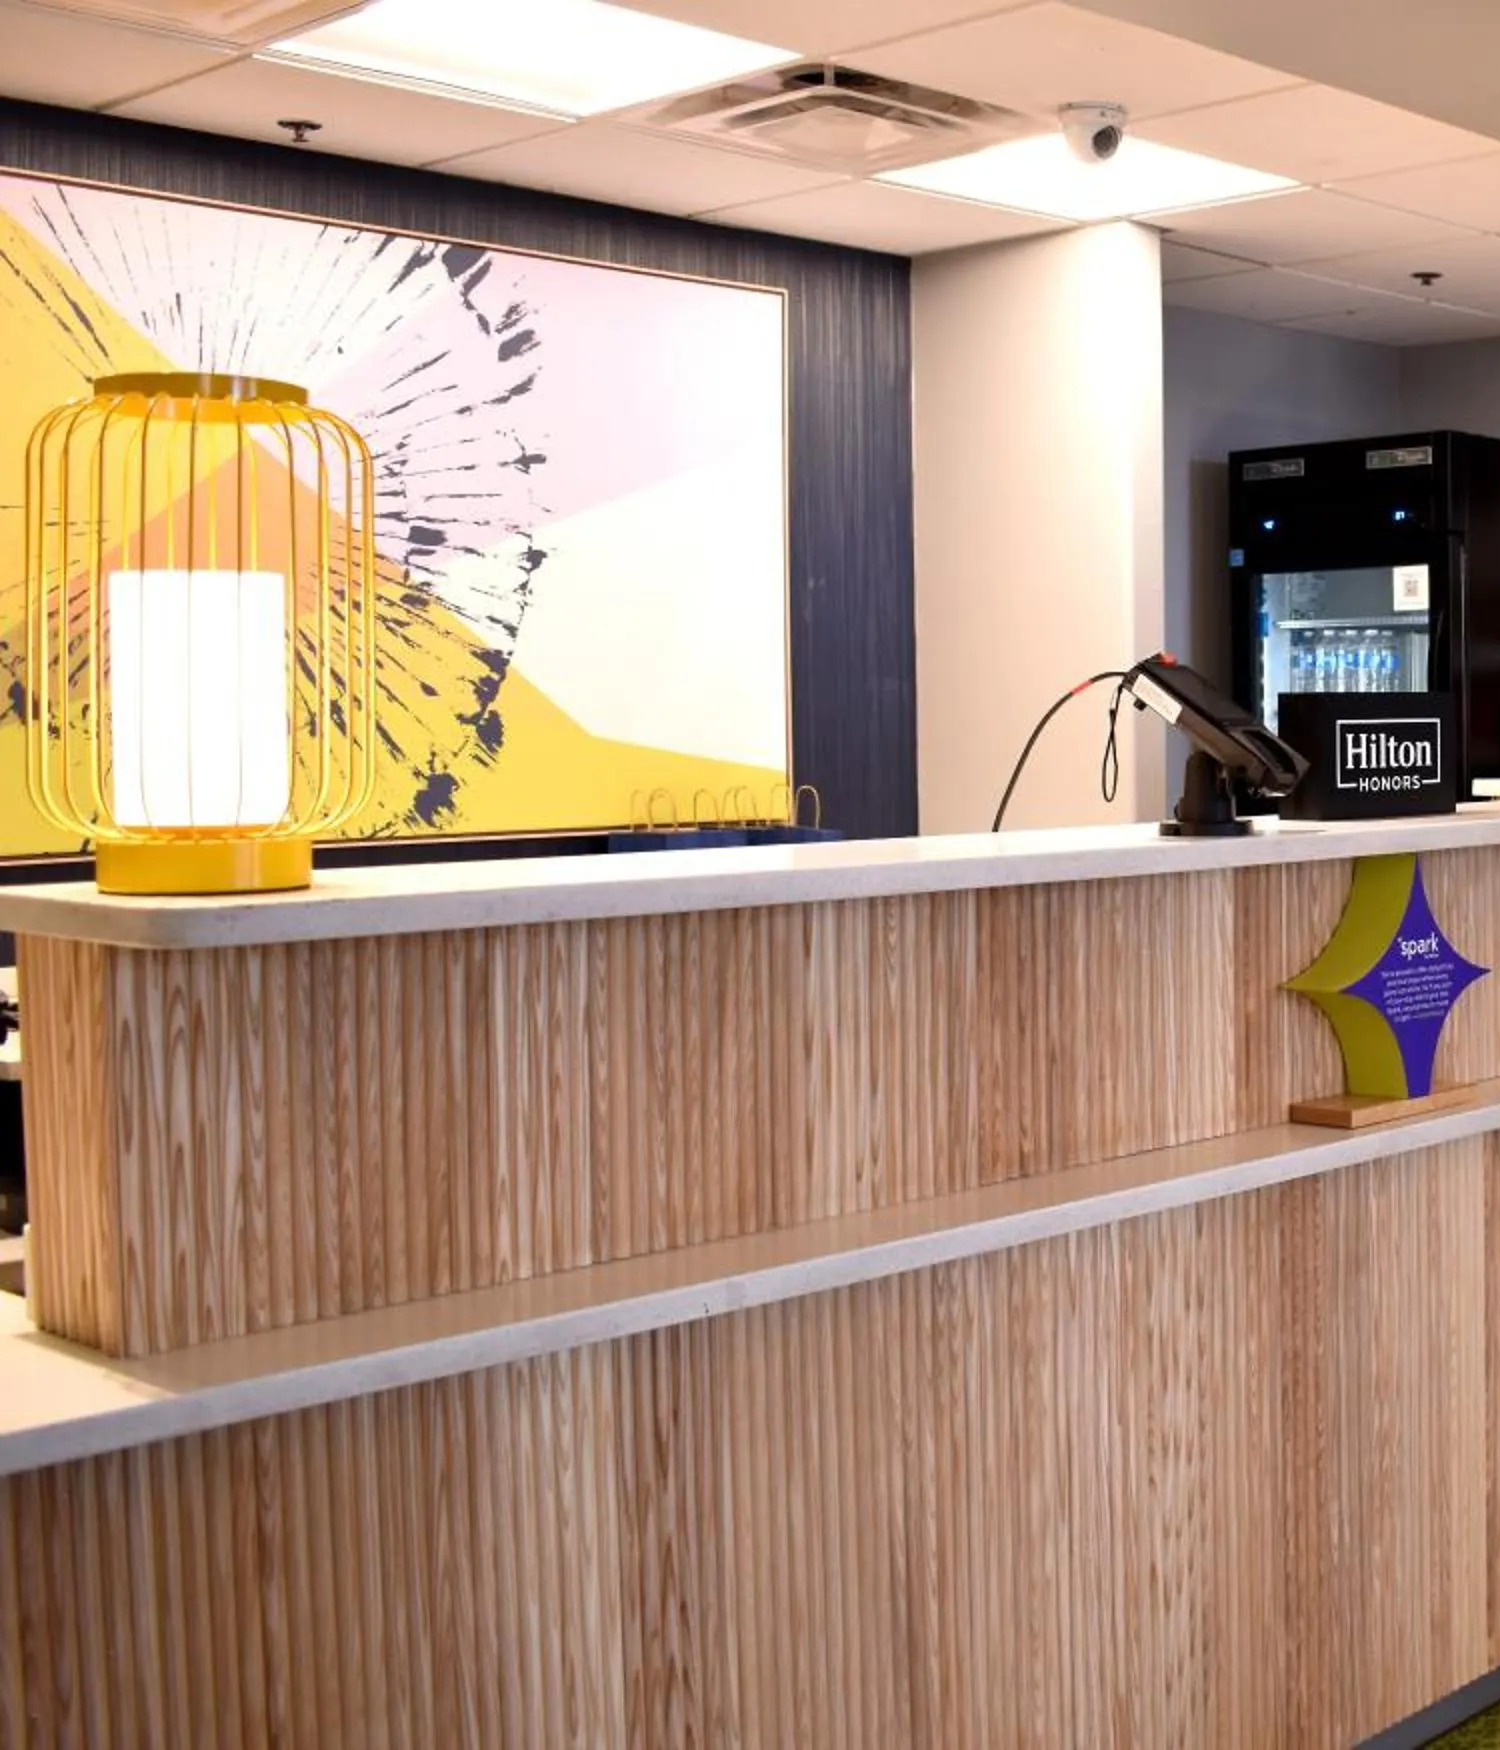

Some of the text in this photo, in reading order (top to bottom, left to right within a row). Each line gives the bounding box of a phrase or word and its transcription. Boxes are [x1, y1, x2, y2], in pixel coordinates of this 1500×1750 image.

[1345, 733, 1432, 769] Hilton
[1359, 775, 1421, 792] HONORS
[1401, 932, 1439, 961] spark
